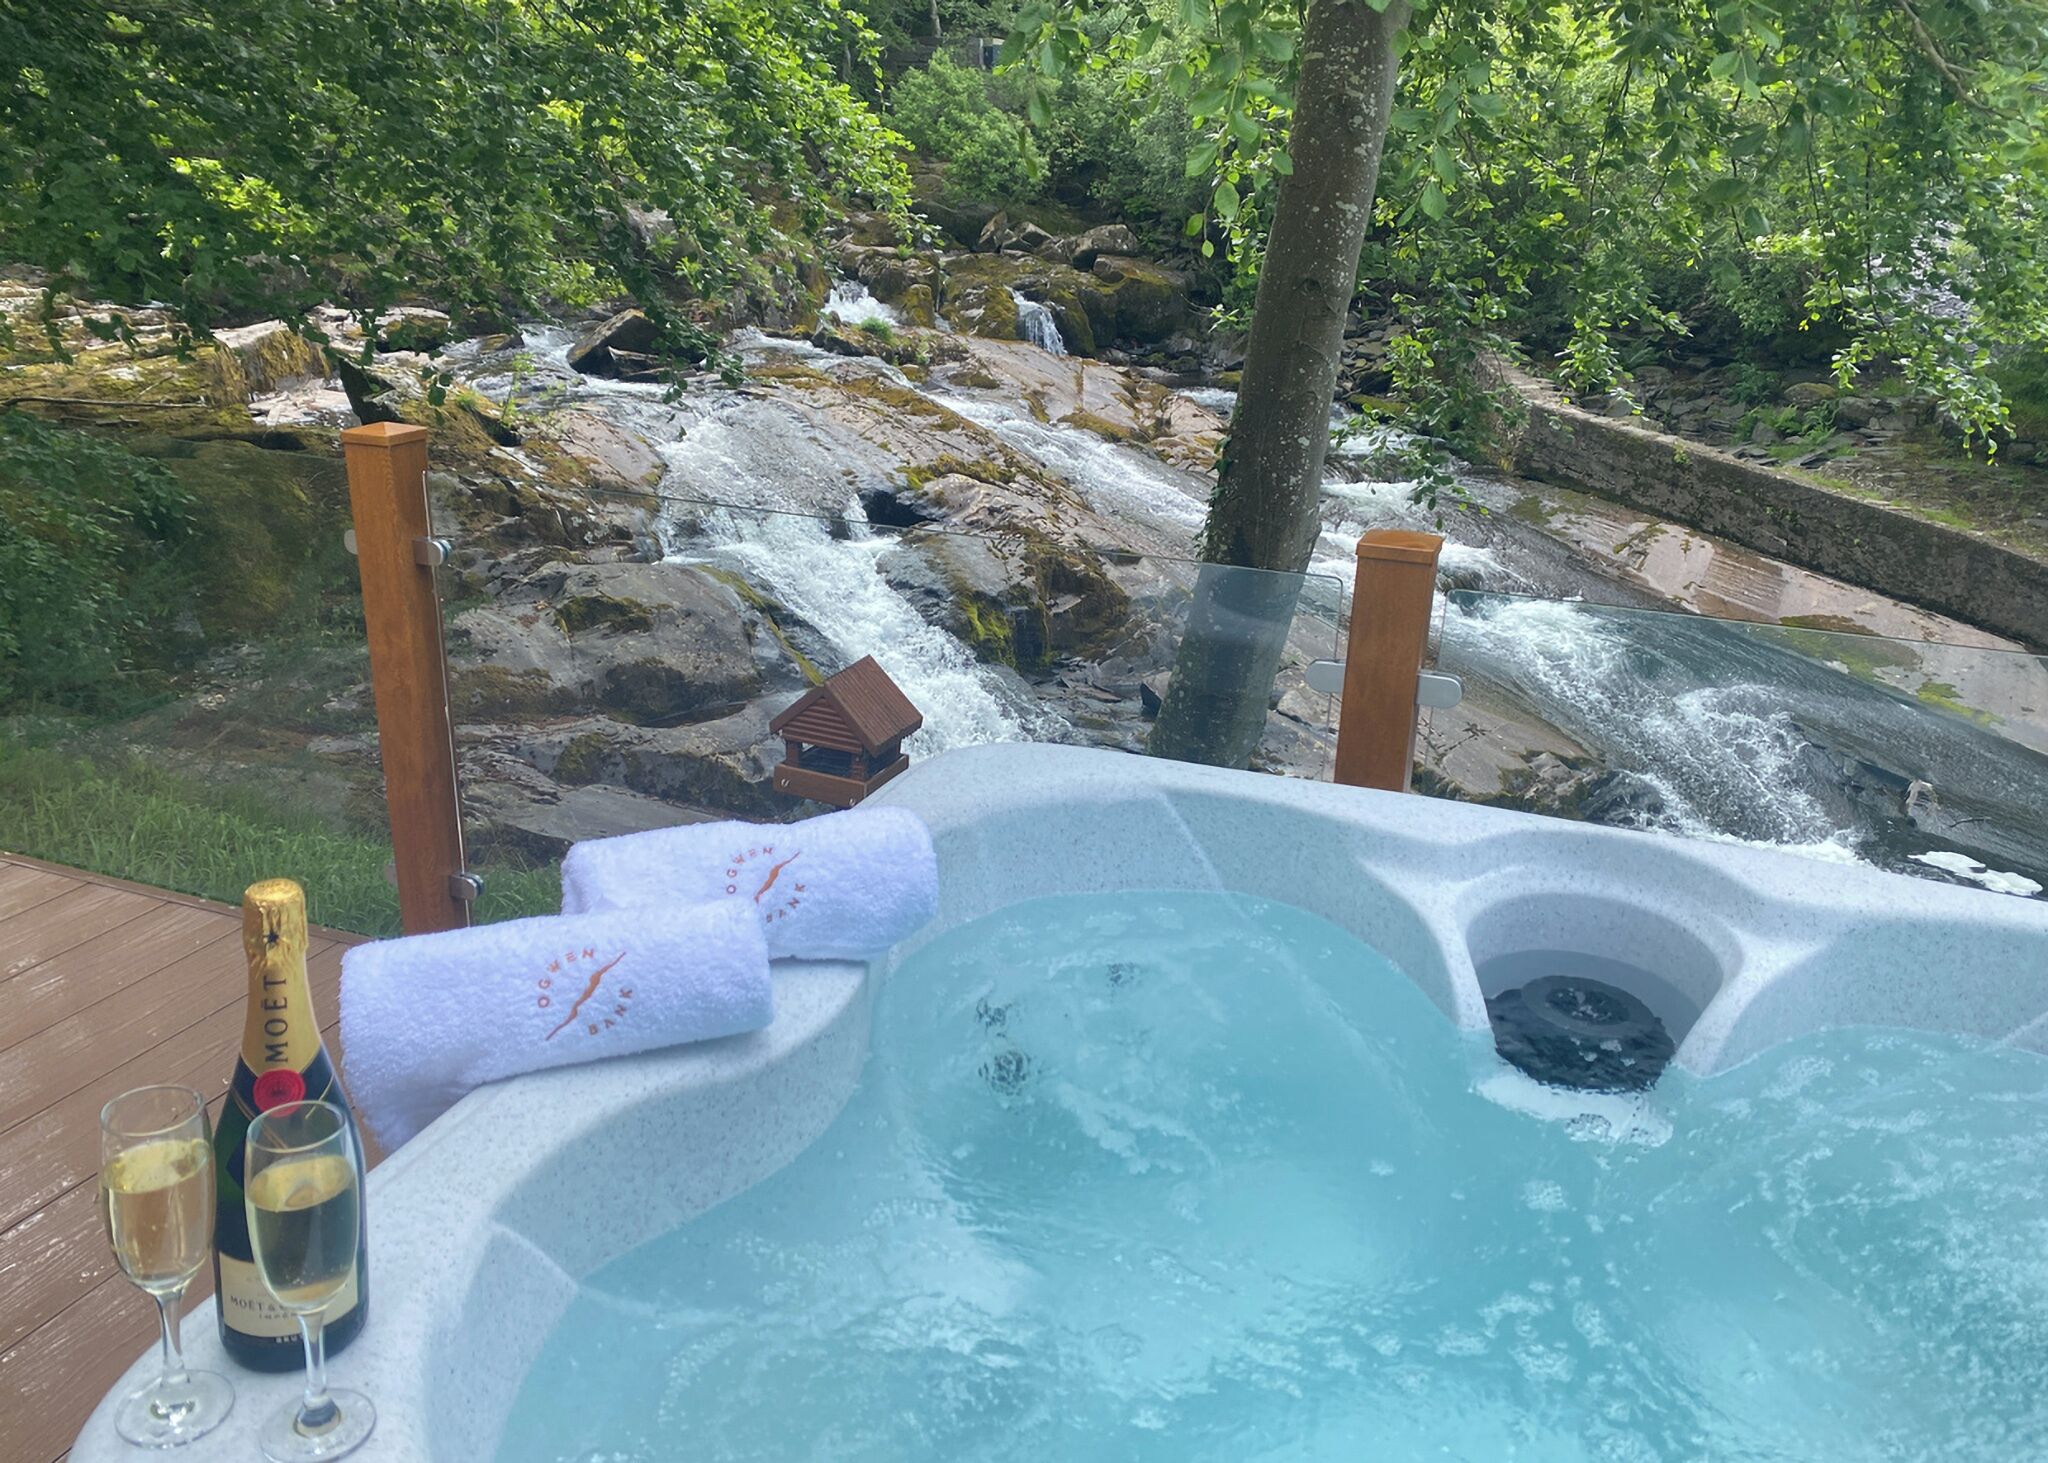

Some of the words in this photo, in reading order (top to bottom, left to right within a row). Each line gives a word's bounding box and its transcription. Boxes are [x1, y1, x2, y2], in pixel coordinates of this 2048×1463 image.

[726, 846, 773, 895] OGWEN
[766, 883, 806, 923] BANK
[538, 948, 594, 1008] OGWEN
[588, 986, 633, 1036] BANK
